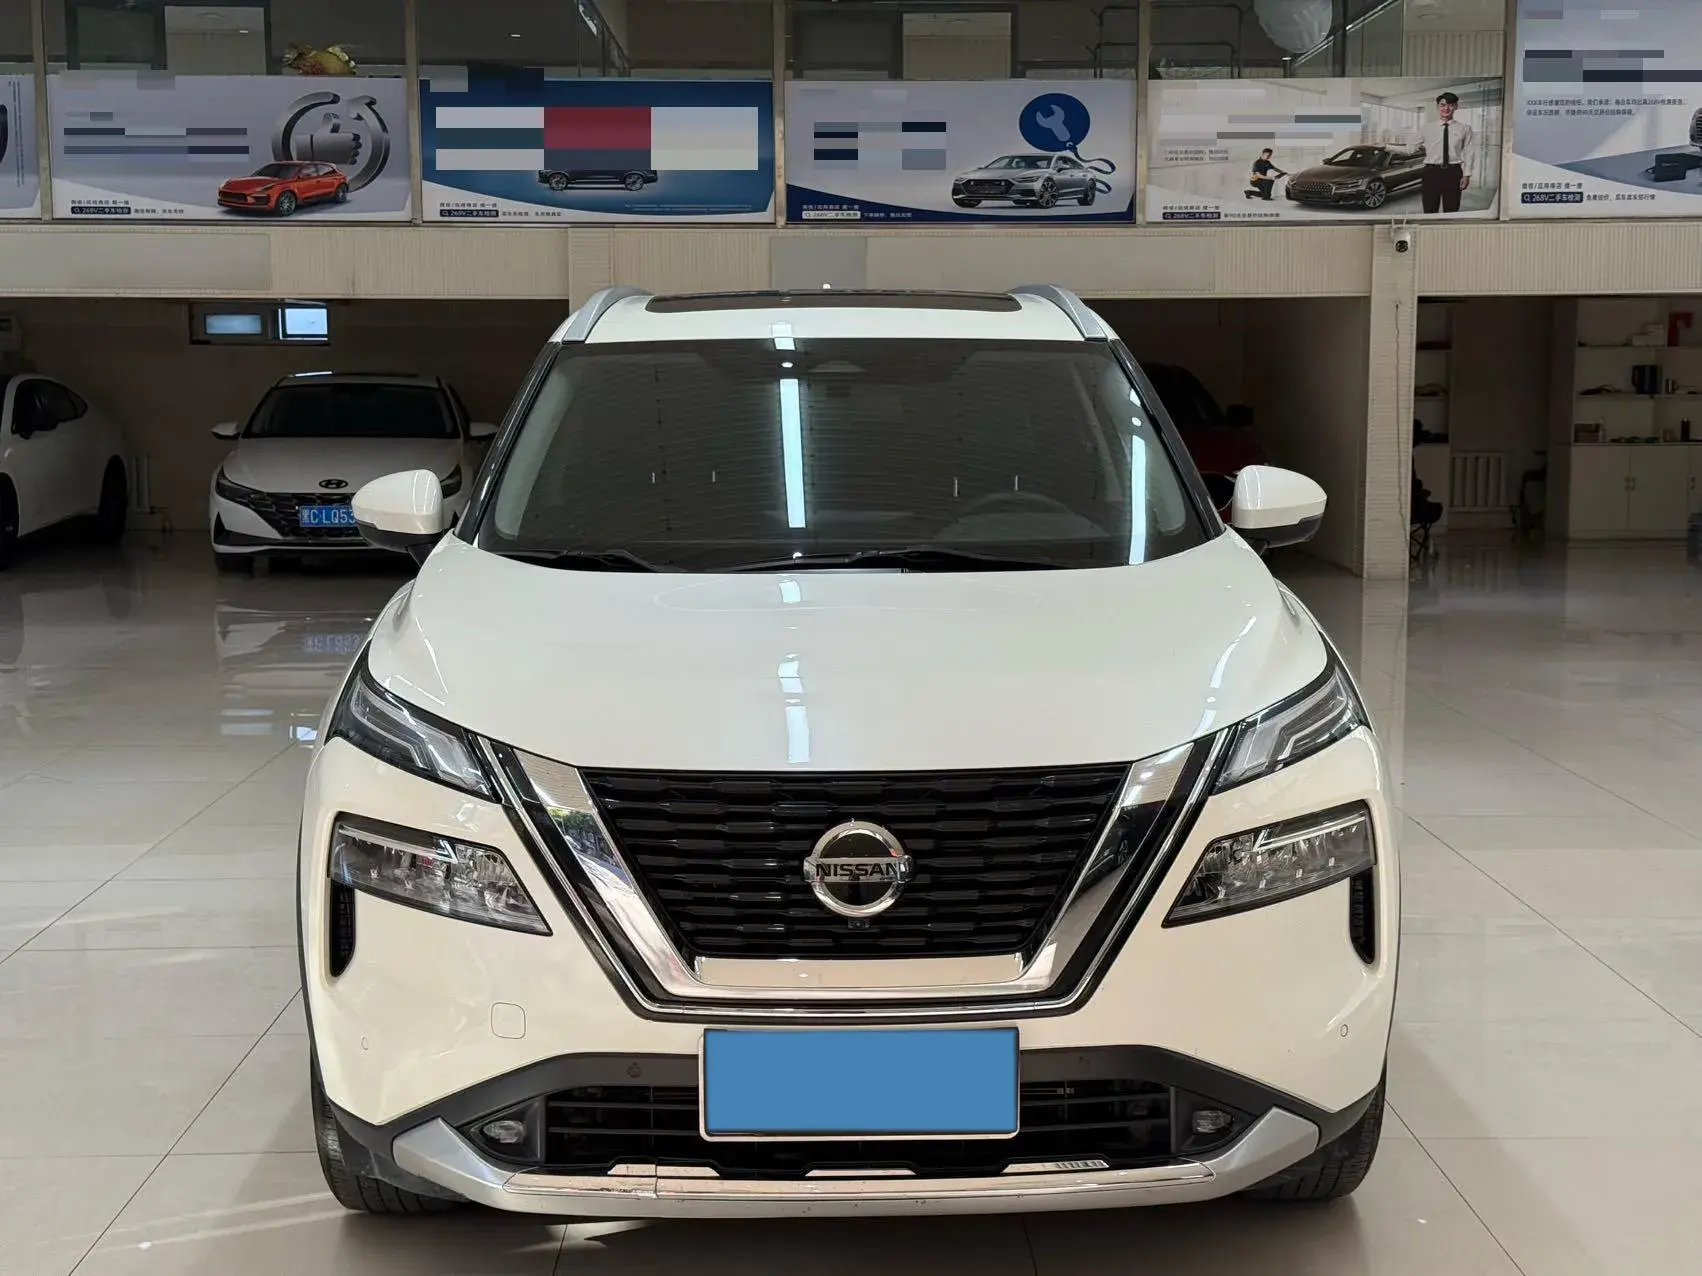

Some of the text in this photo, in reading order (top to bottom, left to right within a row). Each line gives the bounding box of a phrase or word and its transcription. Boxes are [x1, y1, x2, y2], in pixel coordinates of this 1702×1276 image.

[1532, 193, 1582, 202] 268V二手车检测
[816, 863, 899, 877] NISSAN
